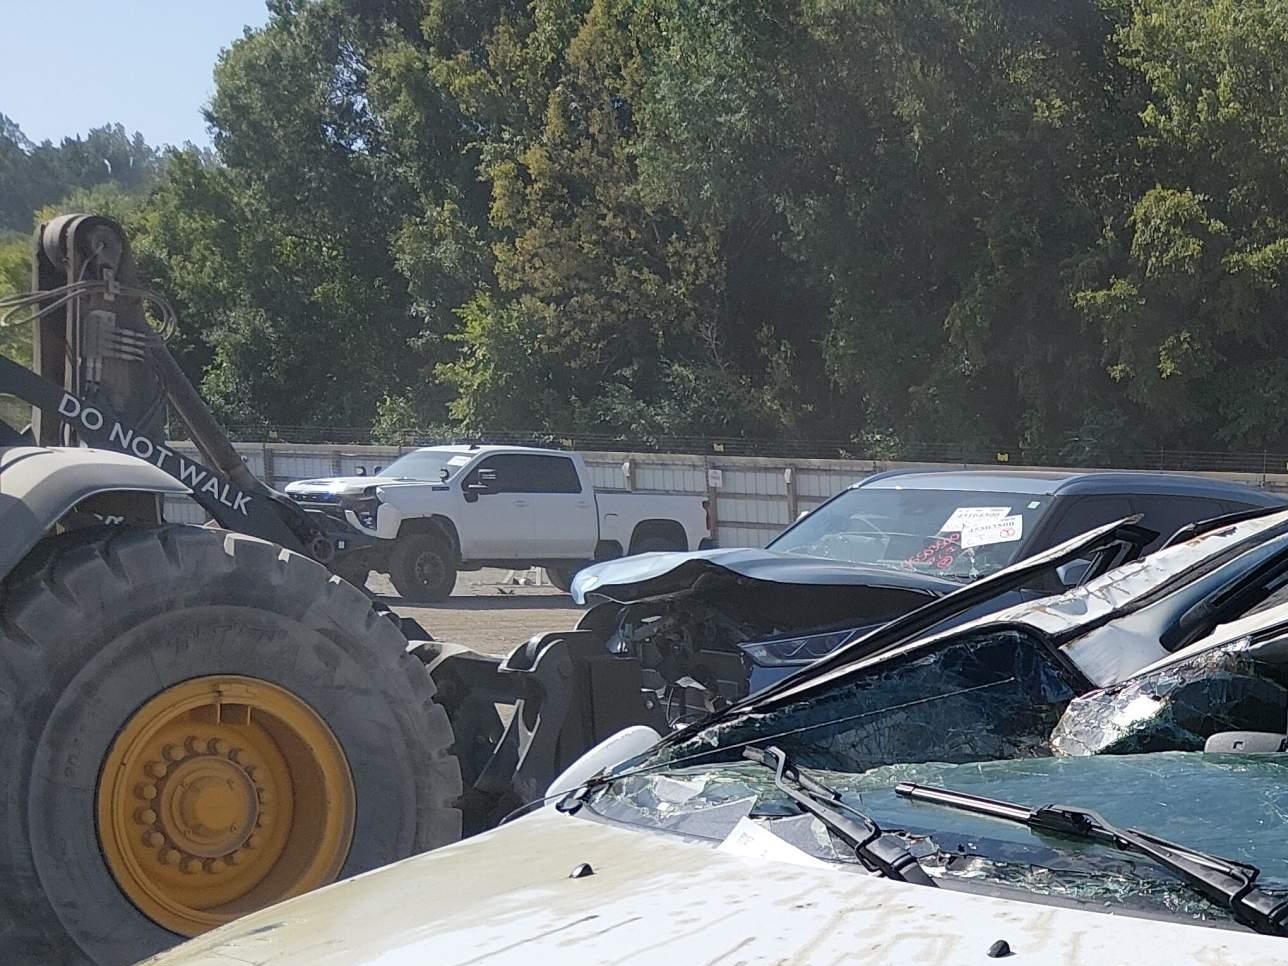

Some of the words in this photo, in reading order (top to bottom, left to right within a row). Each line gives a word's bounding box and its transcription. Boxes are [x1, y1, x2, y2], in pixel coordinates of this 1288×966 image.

[58, 393, 104, 430] DO
[109, 422, 173, 468] NOT
[179, 458, 252, 516] WALK
